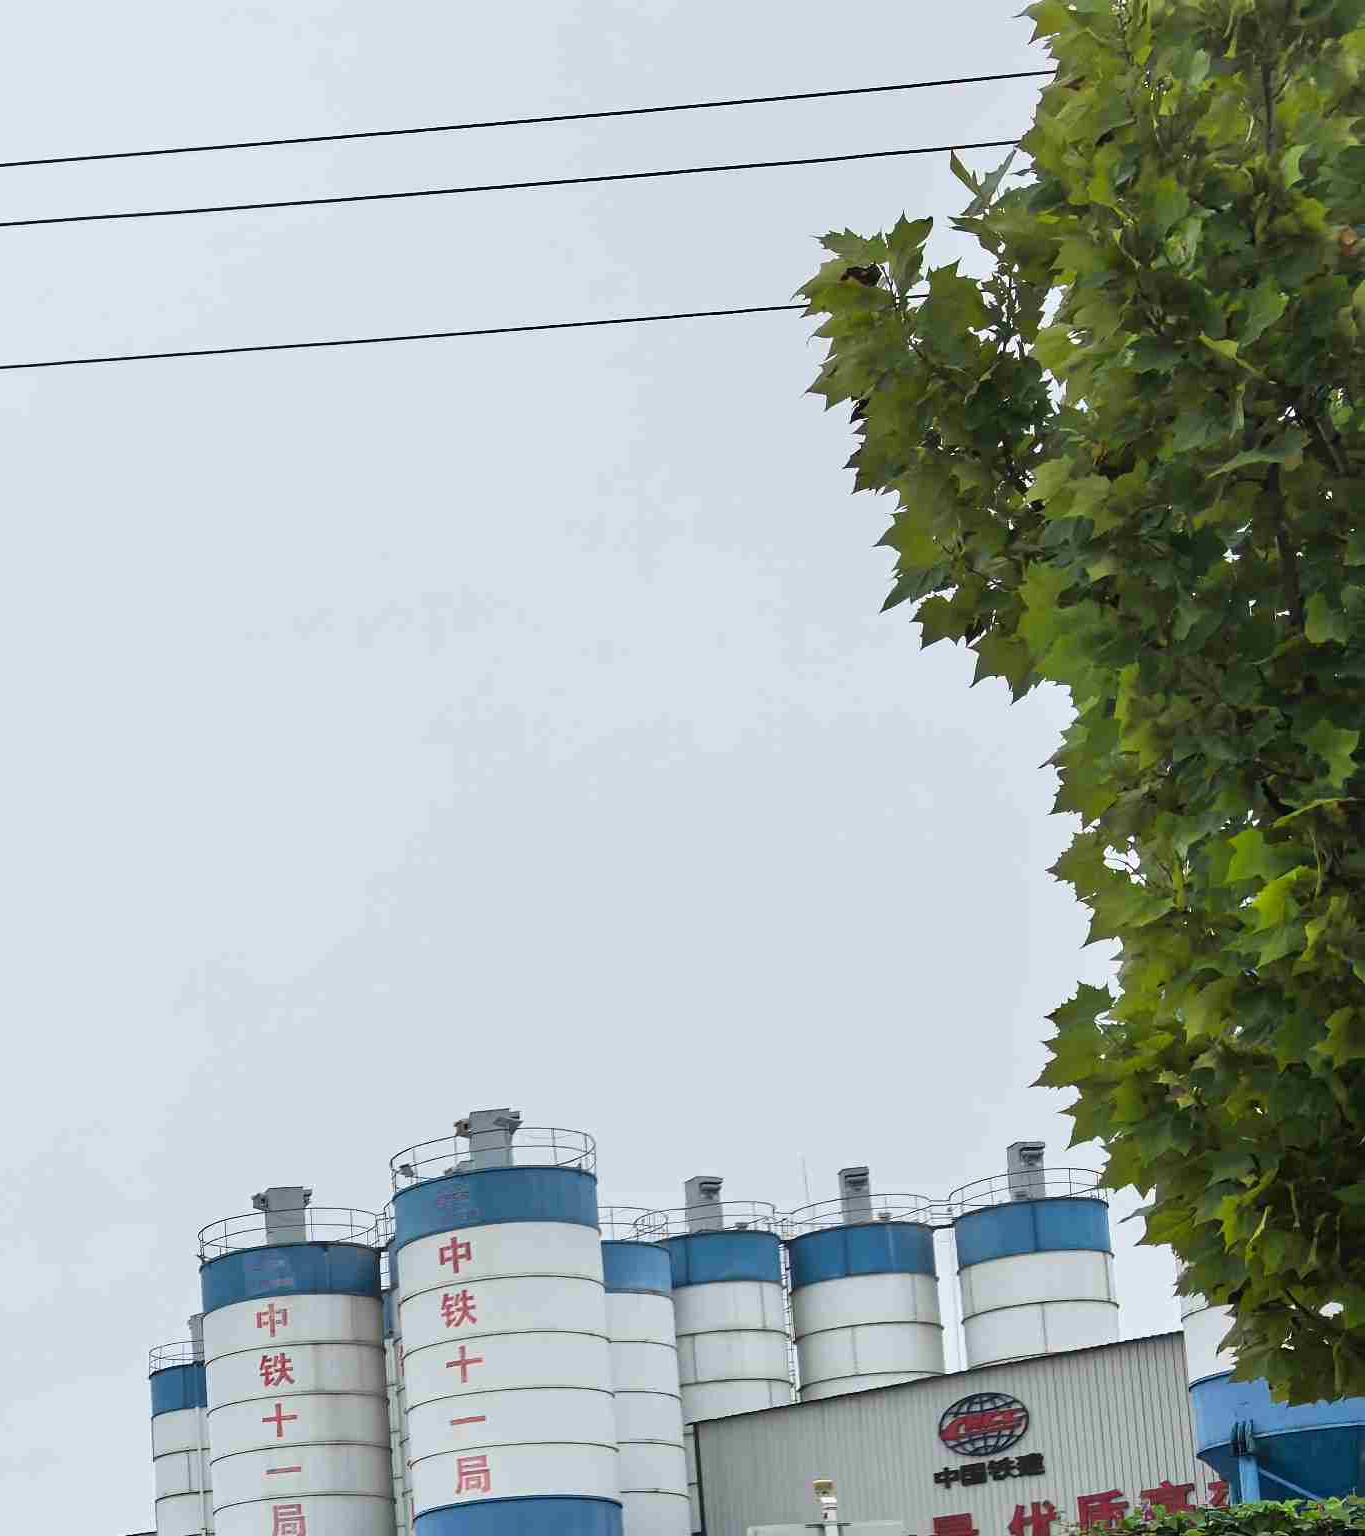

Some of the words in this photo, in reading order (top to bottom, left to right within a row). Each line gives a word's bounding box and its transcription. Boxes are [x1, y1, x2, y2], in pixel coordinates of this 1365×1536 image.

[438, 1236, 493, 1496] 中铁十一局
